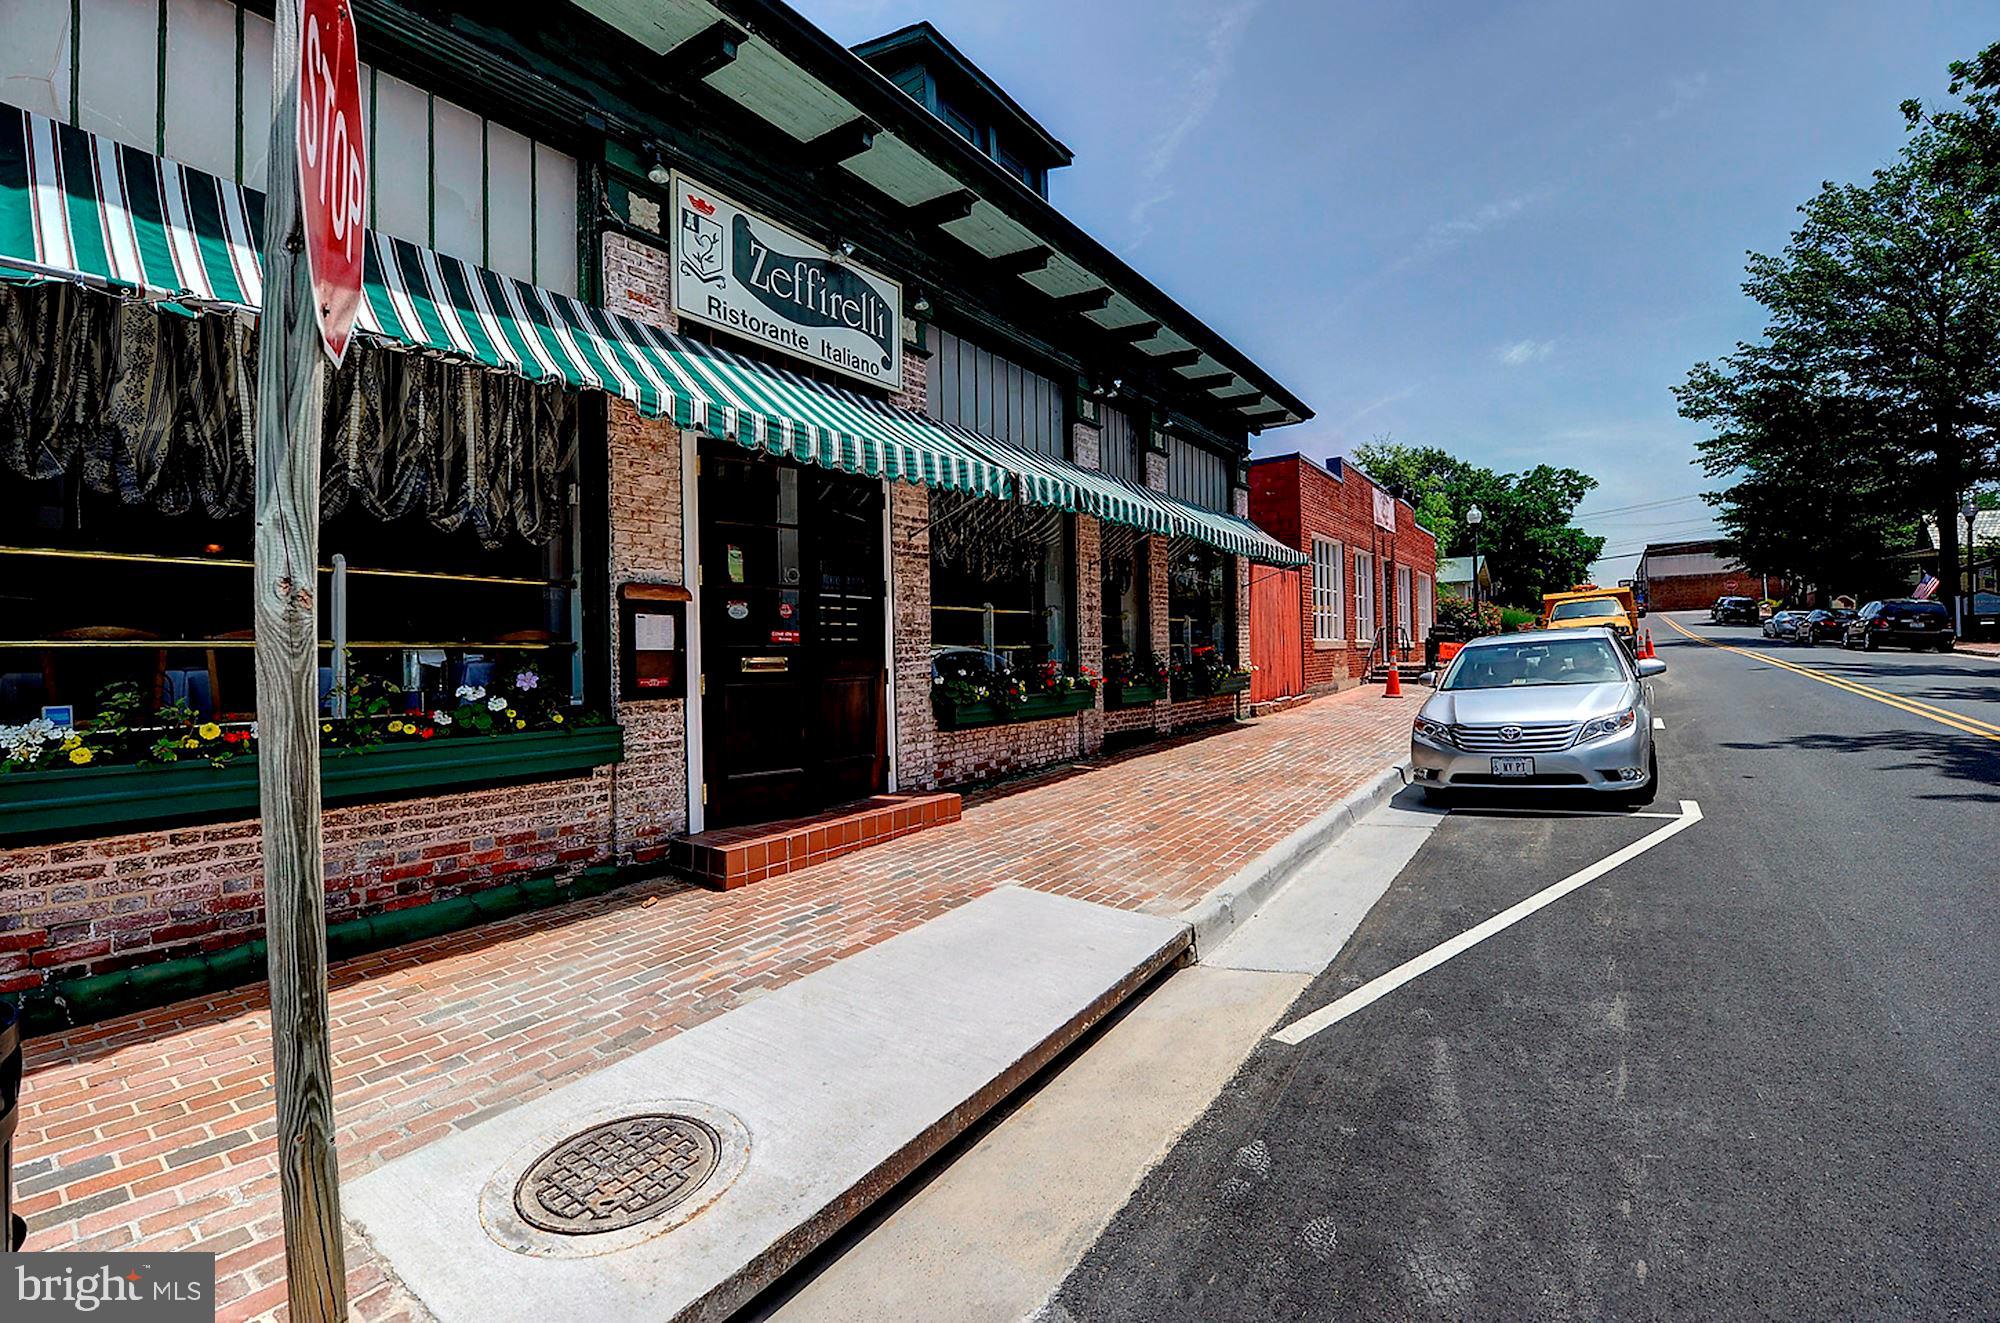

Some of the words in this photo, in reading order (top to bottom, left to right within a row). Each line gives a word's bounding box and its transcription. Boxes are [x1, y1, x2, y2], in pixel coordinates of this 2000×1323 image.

[304, 14, 362, 264] STOP
[707, 295, 809, 350] Ristorante
[820, 339, 880, 376] Italiano
[750, 240, 885, 339] Zeffirelli
